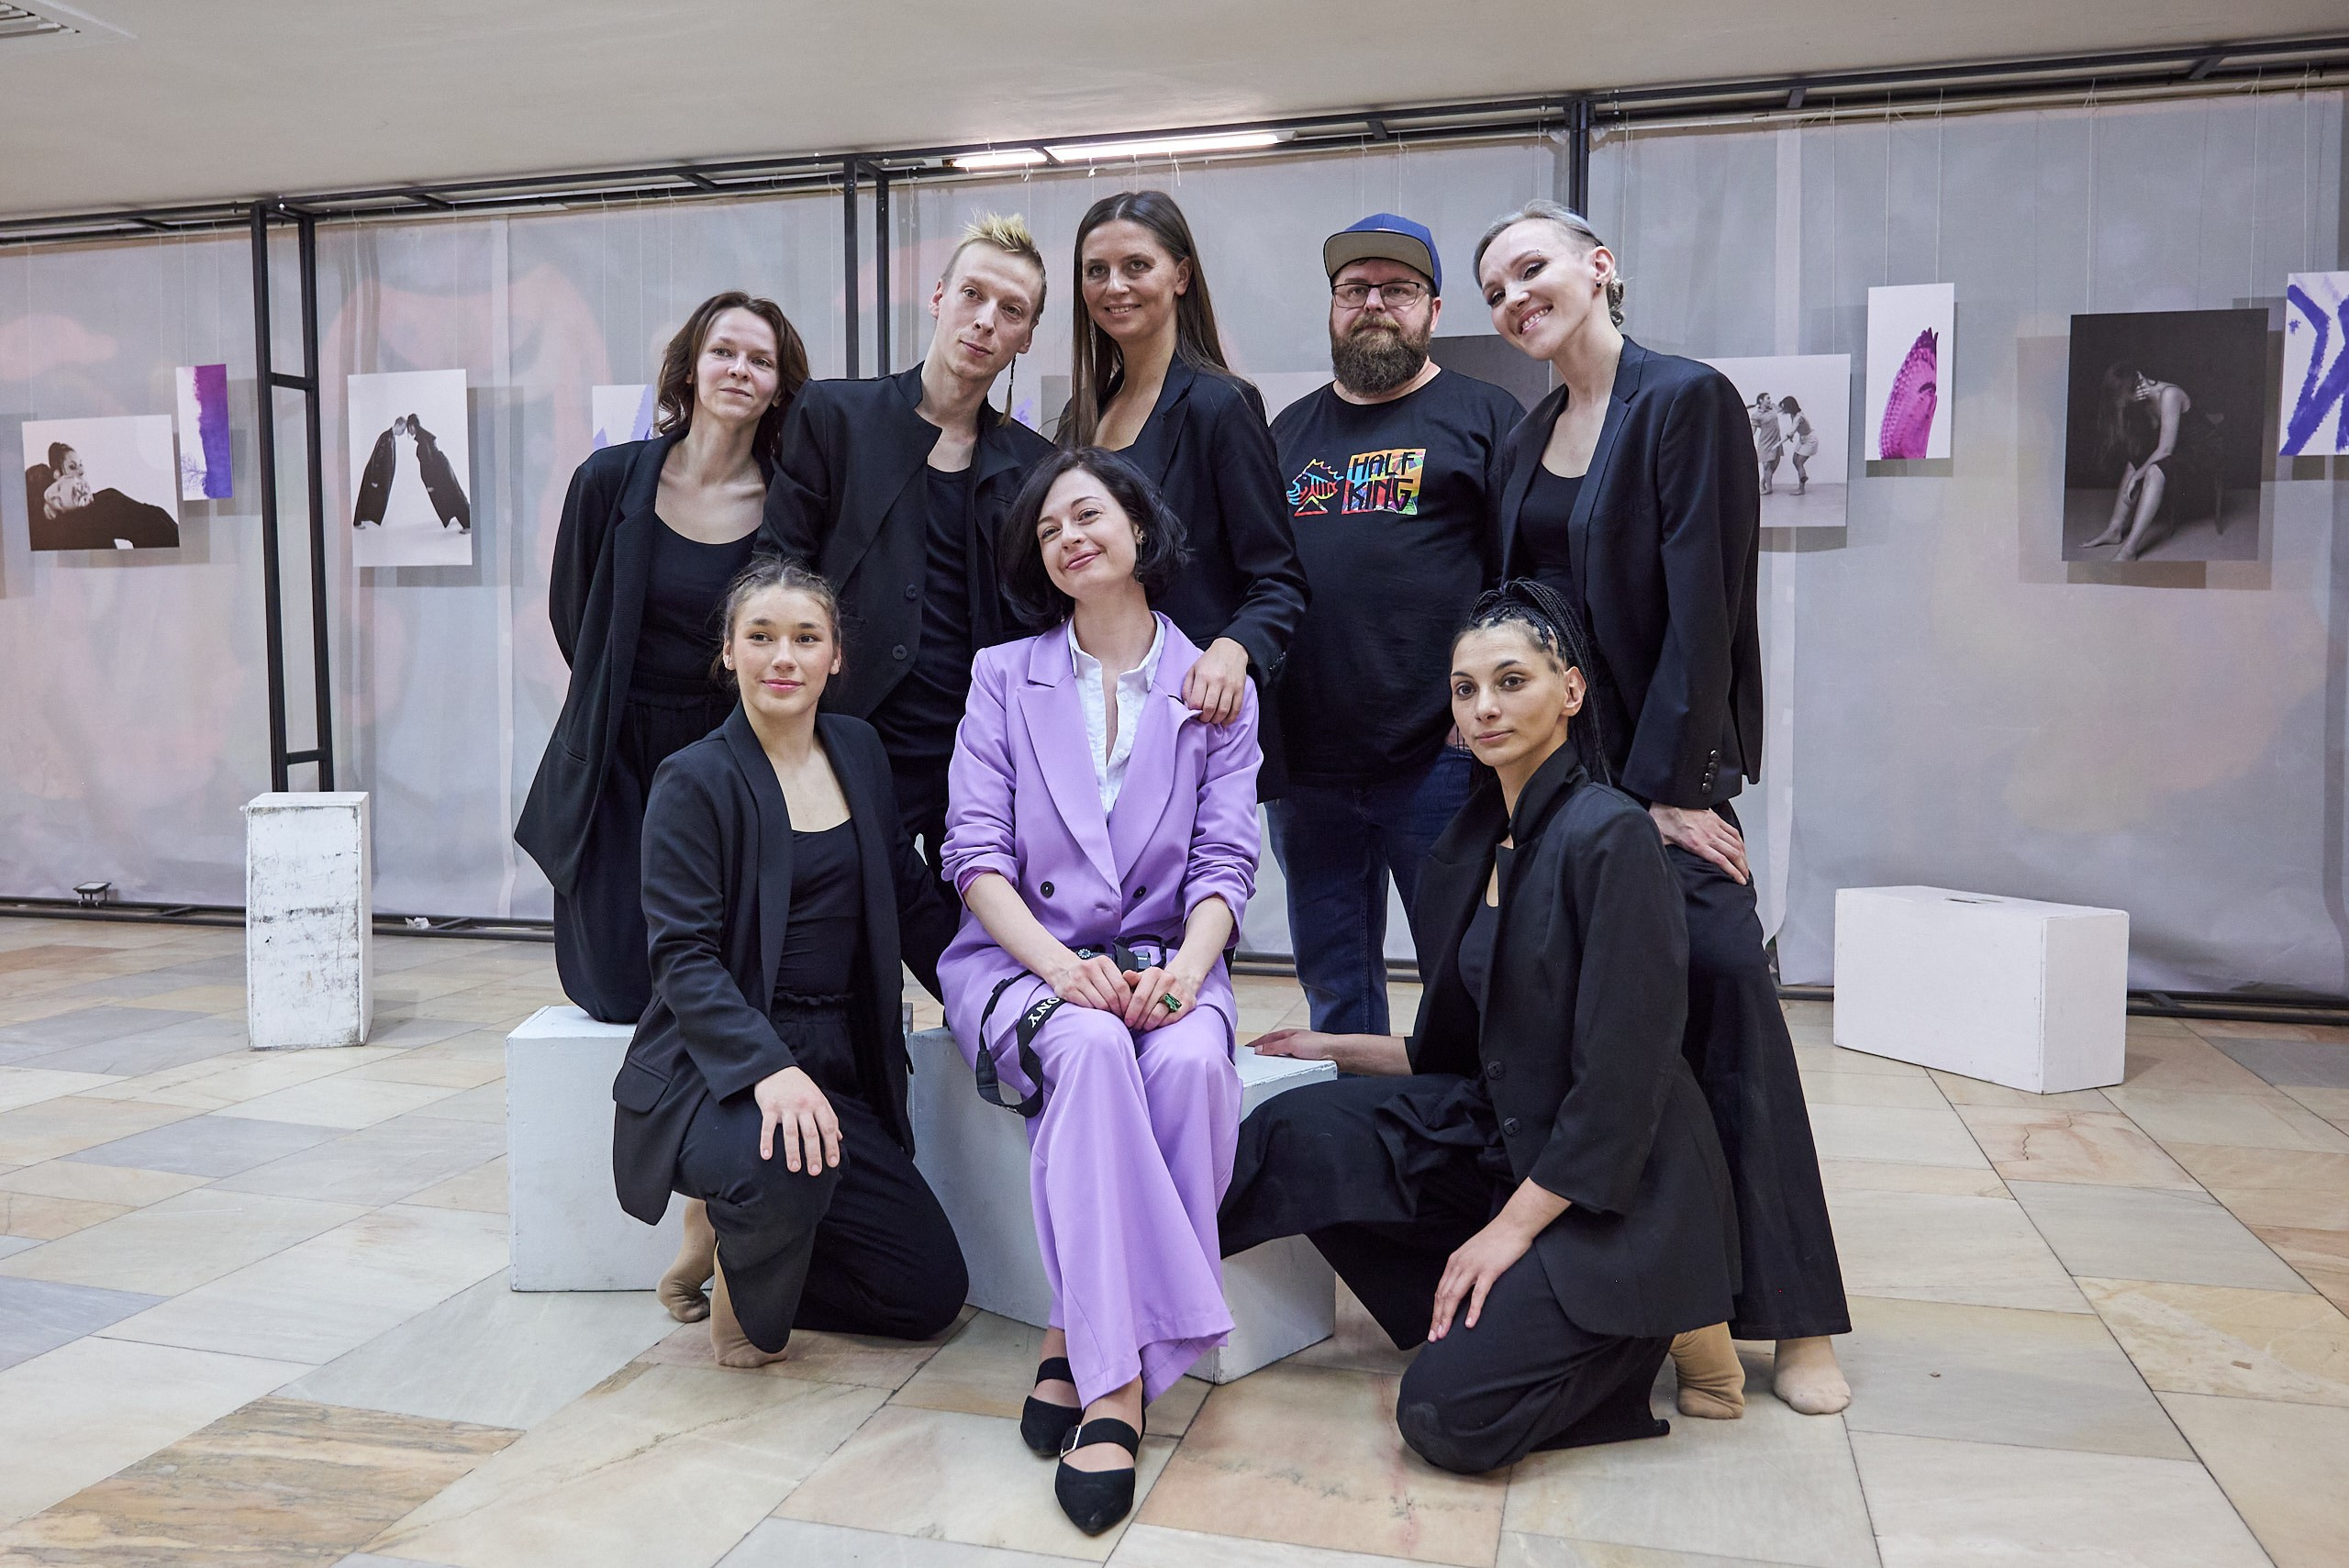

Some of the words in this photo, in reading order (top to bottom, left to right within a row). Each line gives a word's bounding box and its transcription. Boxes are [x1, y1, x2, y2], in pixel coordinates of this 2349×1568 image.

[1352, 452, 1416, 484] HALF
[1348, 478, 1414, 512] KING
[1028, 997, 1061, 1029] ONY
